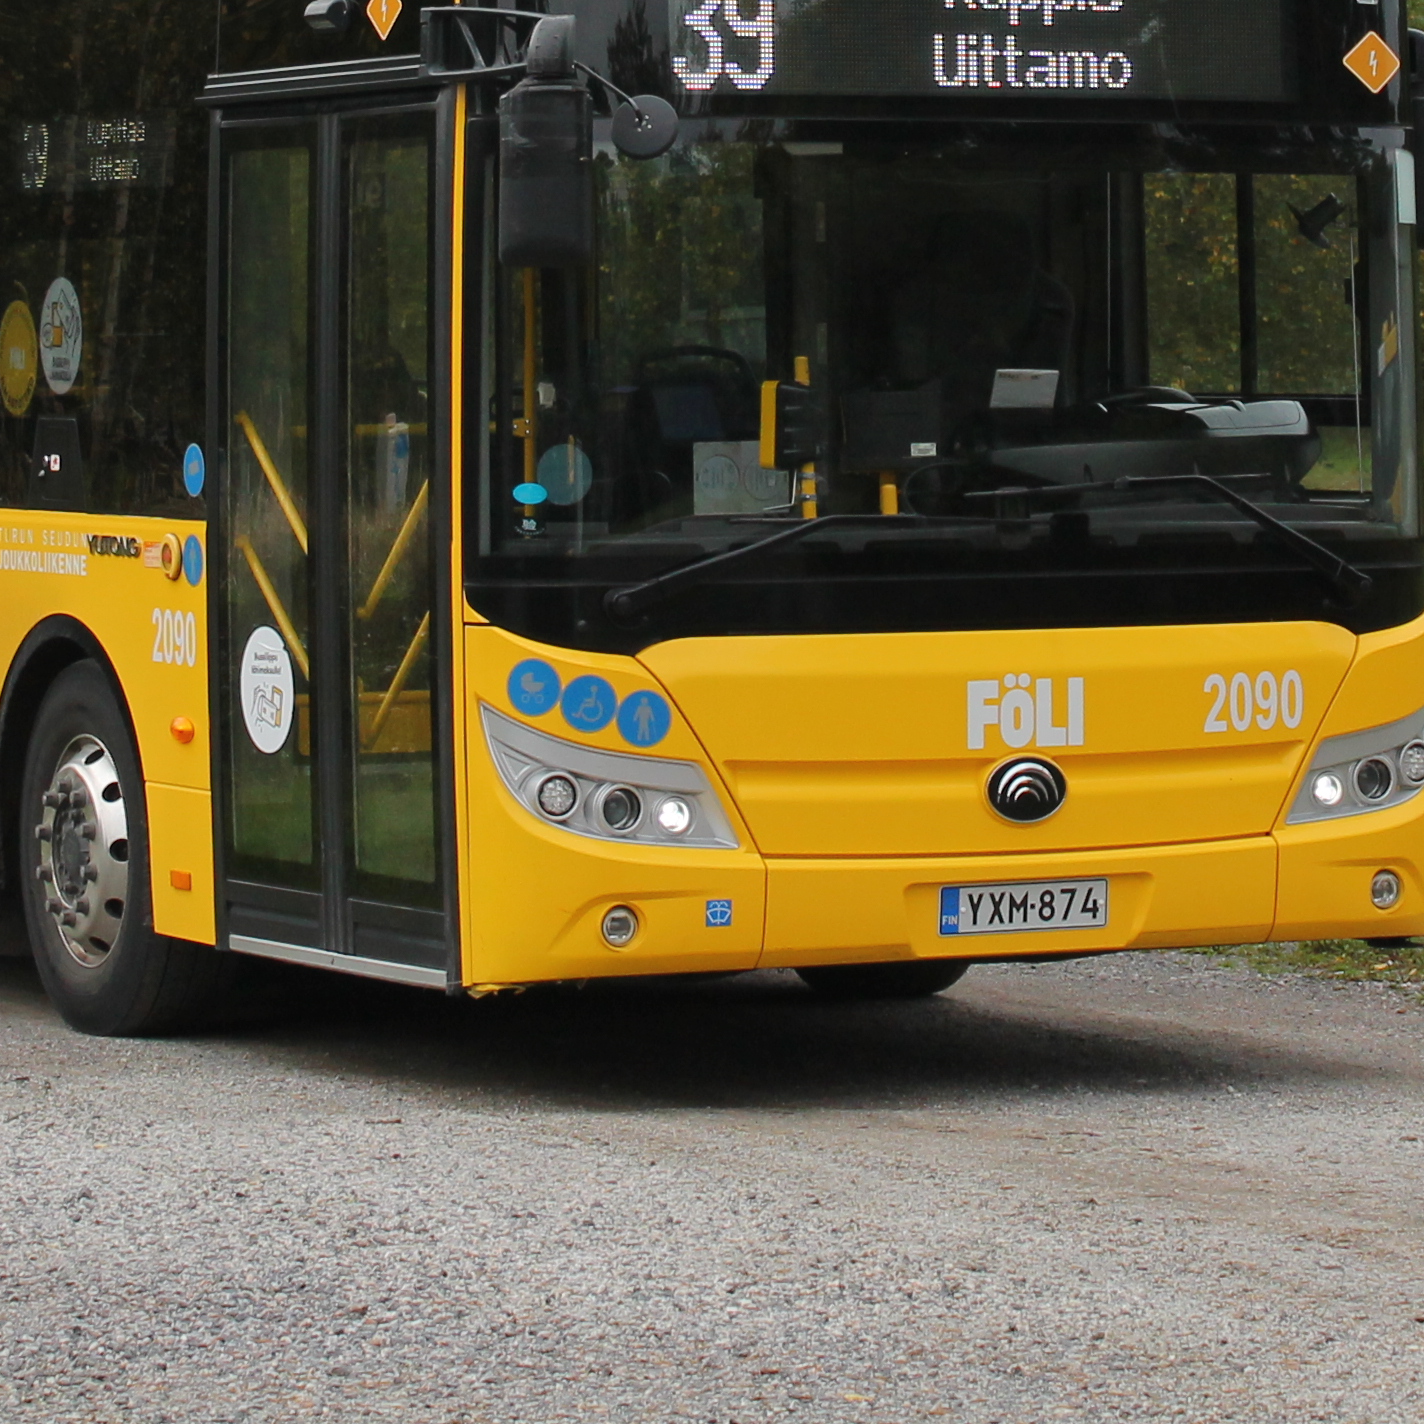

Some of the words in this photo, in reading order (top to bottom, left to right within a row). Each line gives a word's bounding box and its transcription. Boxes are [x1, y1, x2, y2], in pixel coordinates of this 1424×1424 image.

[932, 33, 1133, 89] Uittamo
[87, 533, 142, 558] YUTONG
[152, 607, 197, 667] 2090
[967, 673, 1084, 750] FÖLI
[1203, 669, 1304, 733] 2090
[942, 914, 958, 926] FIN
[967, 886, 1100, 926] YXM-874
